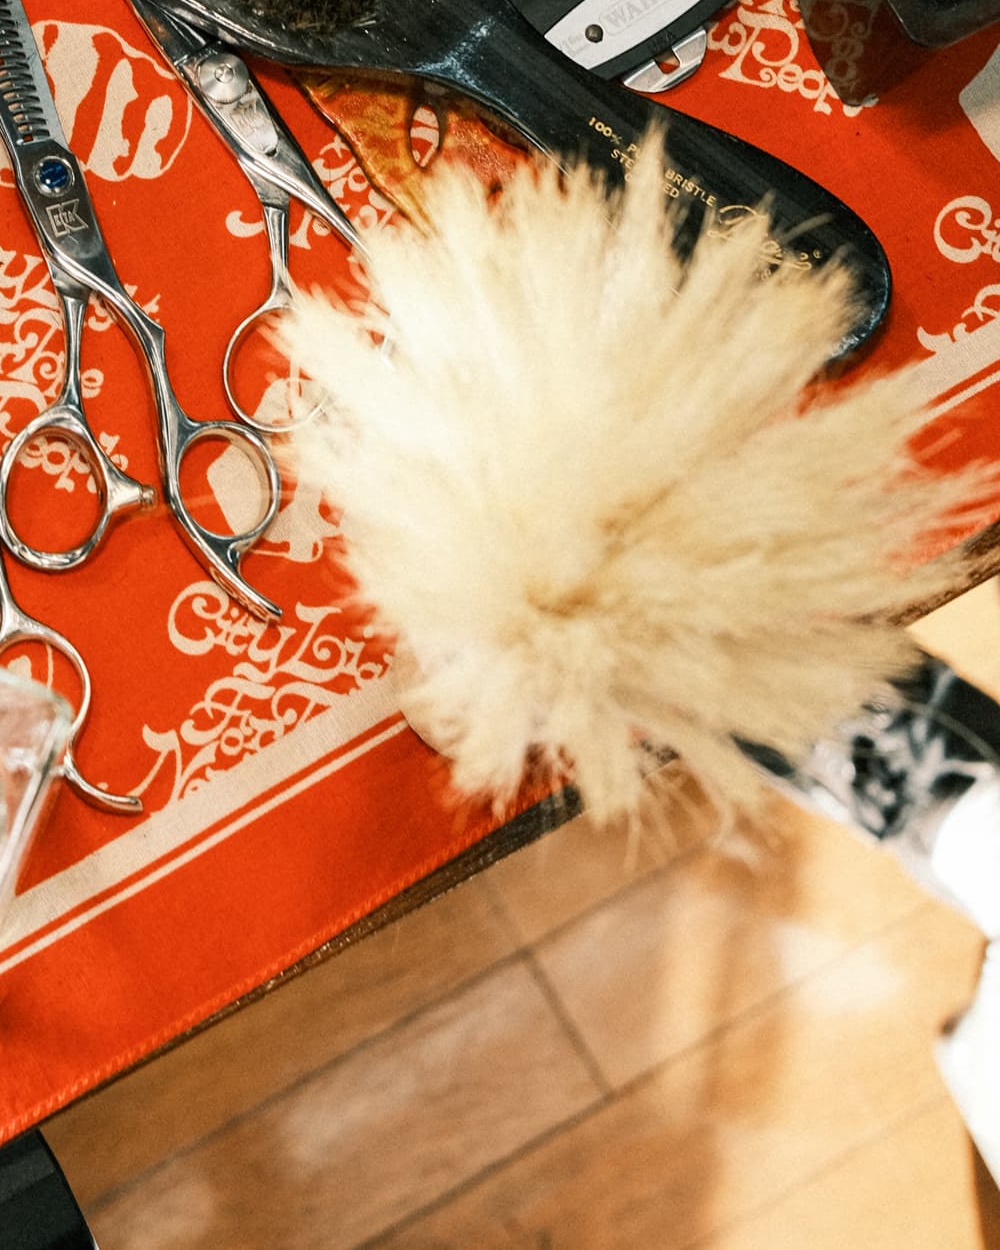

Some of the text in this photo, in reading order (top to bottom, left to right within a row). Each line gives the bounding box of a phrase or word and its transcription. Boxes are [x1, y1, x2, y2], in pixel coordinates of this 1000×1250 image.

[587, 116, 622, 145] 100%
[665, 169, 718, 207] BRISTLE
[168, 580, 298, 684] City
